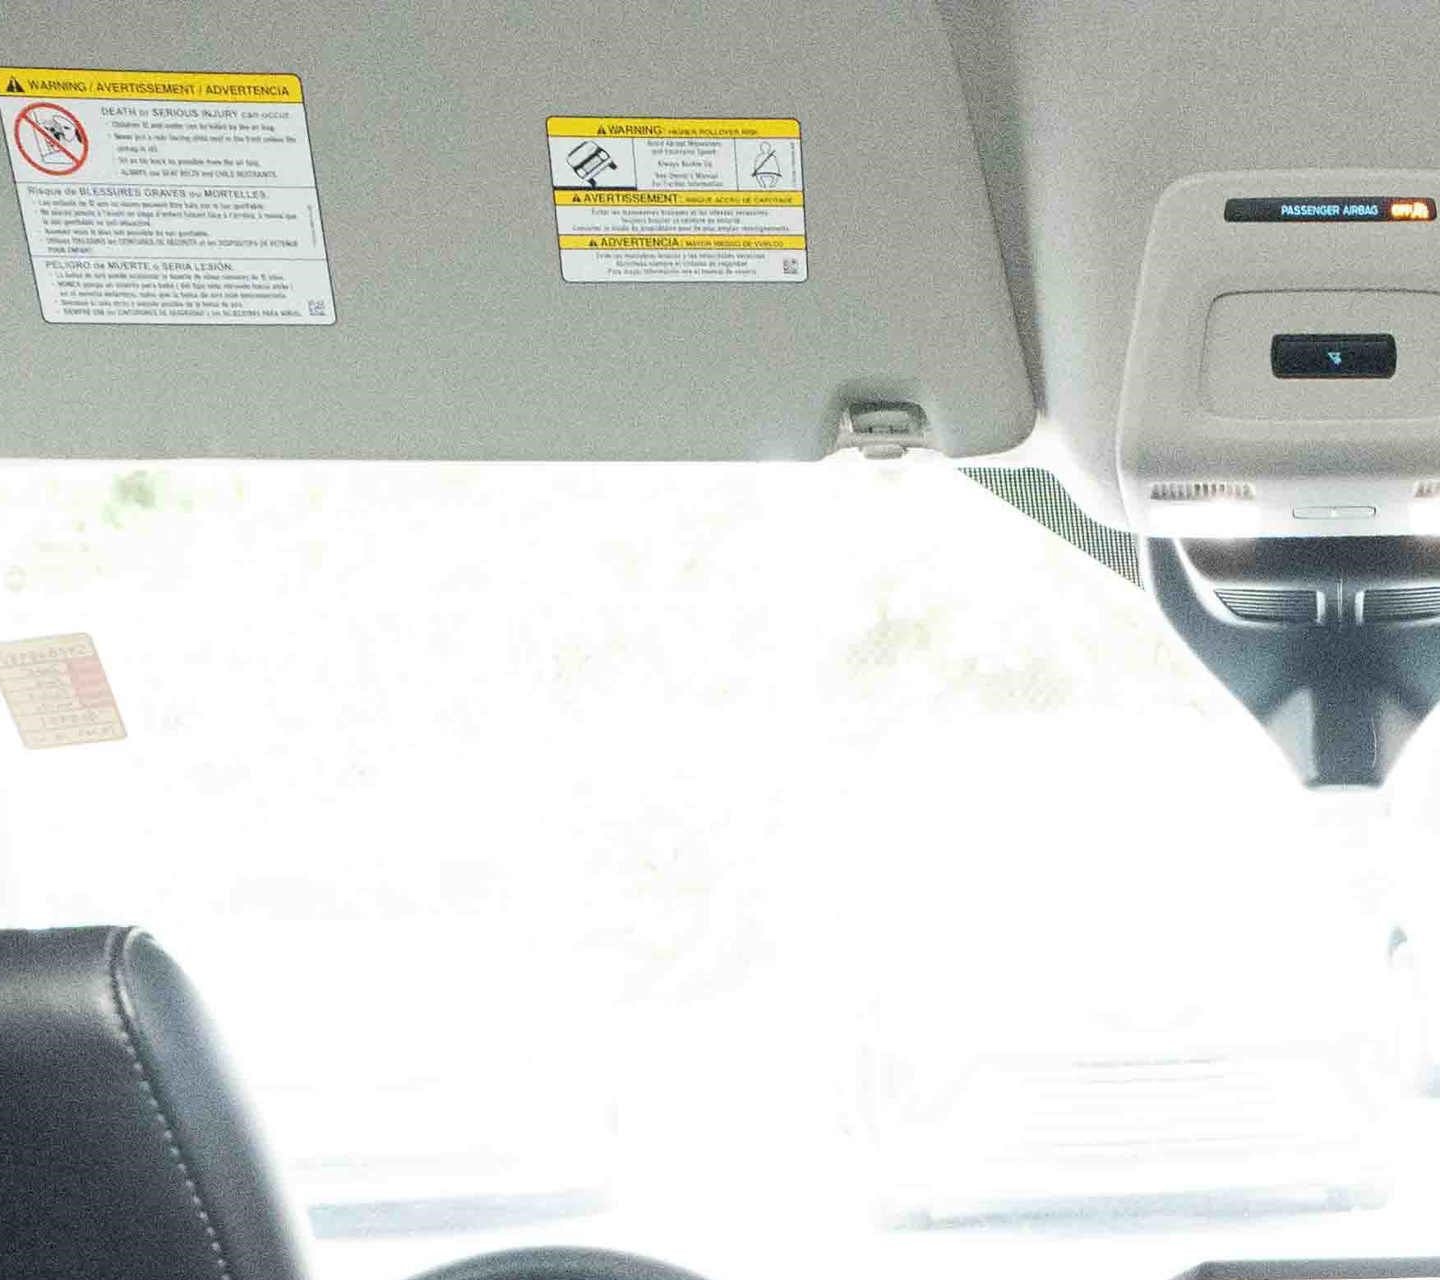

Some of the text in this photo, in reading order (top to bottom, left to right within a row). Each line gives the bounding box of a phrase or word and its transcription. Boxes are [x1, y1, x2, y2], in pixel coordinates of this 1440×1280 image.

[28, 79, 88, 93] WARNING
[95, 81, 196, 96] AVERTISSEMENT
[205, 84, 290, 98] ADVERTENCIA
[100, 106, 137, 118] DEATH
[150, 107, 200, 119] SERIOUS
[201, 107, 239, 119] INJURY
[80, 187, 142, 199] BLESSURES
[144, 188, 187, 200] GRAVES
[1280, 204, 1340, 216] PASSENGER
[1342, 204, 1379, 216] AIRBAG
[45, 260, 91, 272] PELIGRO
[162, 261, 195, 272] SERIA
